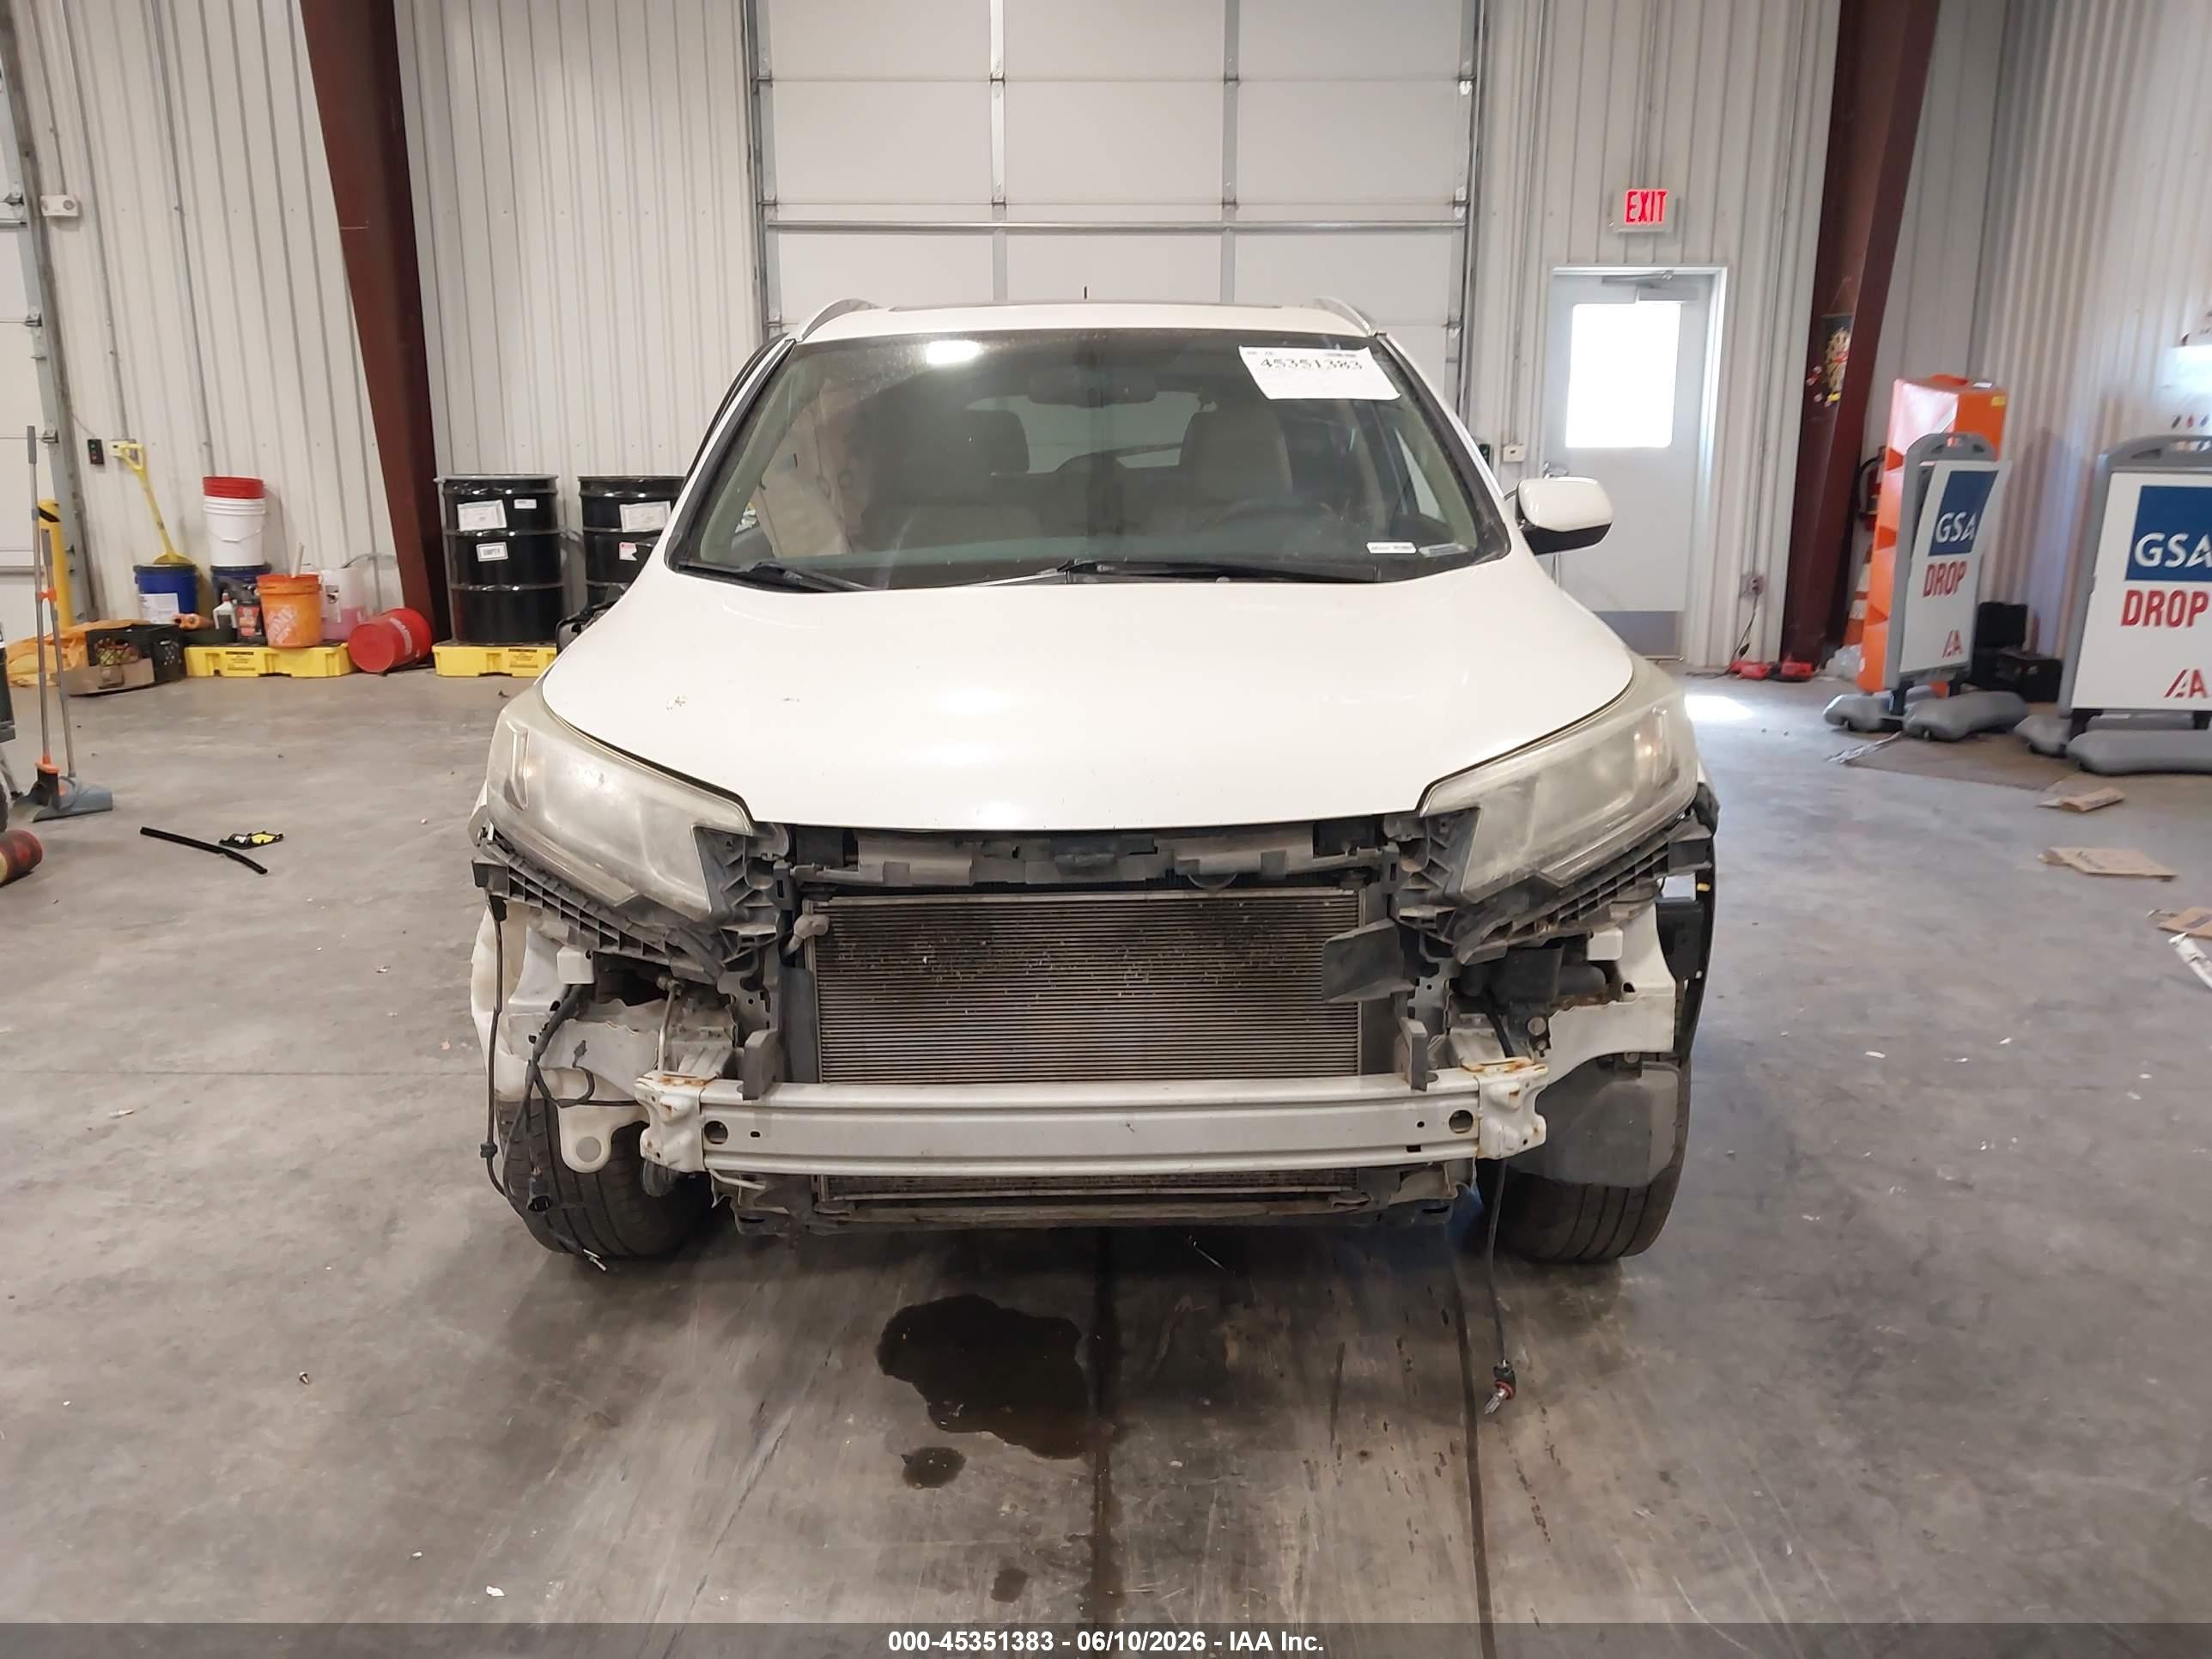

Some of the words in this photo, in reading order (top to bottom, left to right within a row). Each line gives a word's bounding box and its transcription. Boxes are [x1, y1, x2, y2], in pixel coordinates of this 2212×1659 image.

[1626, 190, 1668, 223] EXIT
[1936, 511, 1977, 544] GSA
[2134, 532, 2212, 568] GSA
[1922, 560, 1967, 599] DROP
[2120, 589, 2210, 628] DROP
